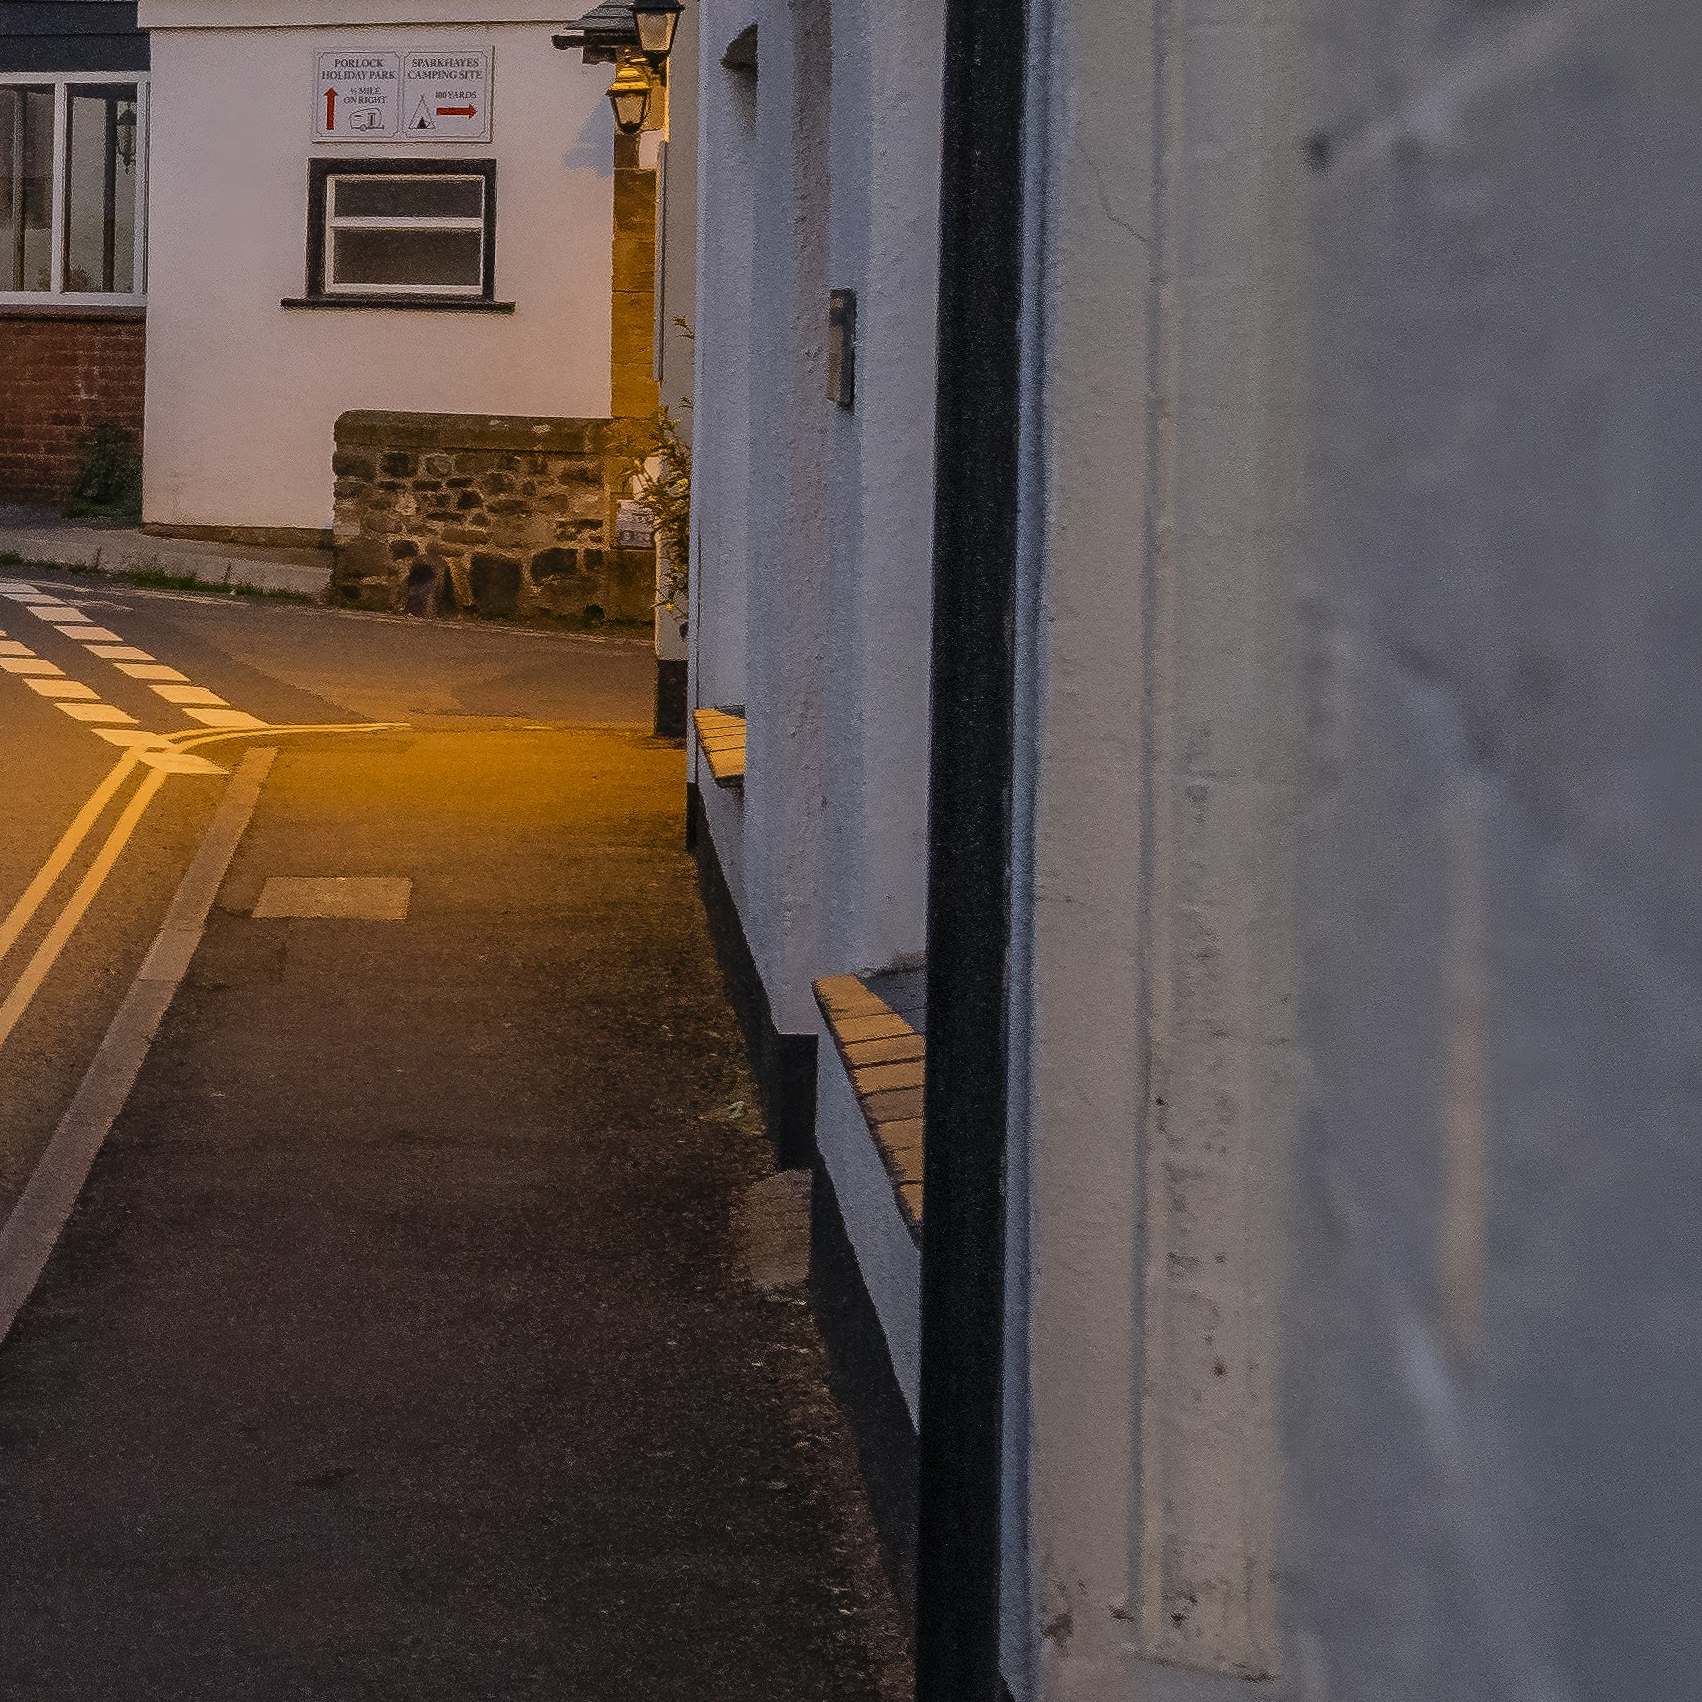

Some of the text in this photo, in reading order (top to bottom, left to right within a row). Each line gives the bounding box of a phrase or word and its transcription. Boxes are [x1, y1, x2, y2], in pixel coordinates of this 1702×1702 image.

[334, 58, 384, 68] PORLOCK
[411, 58, 479, 68] SPARKHAYES
[321, 70, 396, 80] HOLIDAY PARK
[407, 70, 483, 80] CAMPING SITE
[358, 86, 382, 95] MILE
[447, 91, 477, 99] YARDS
[343, 96, 387, 104] ON RIGHT
